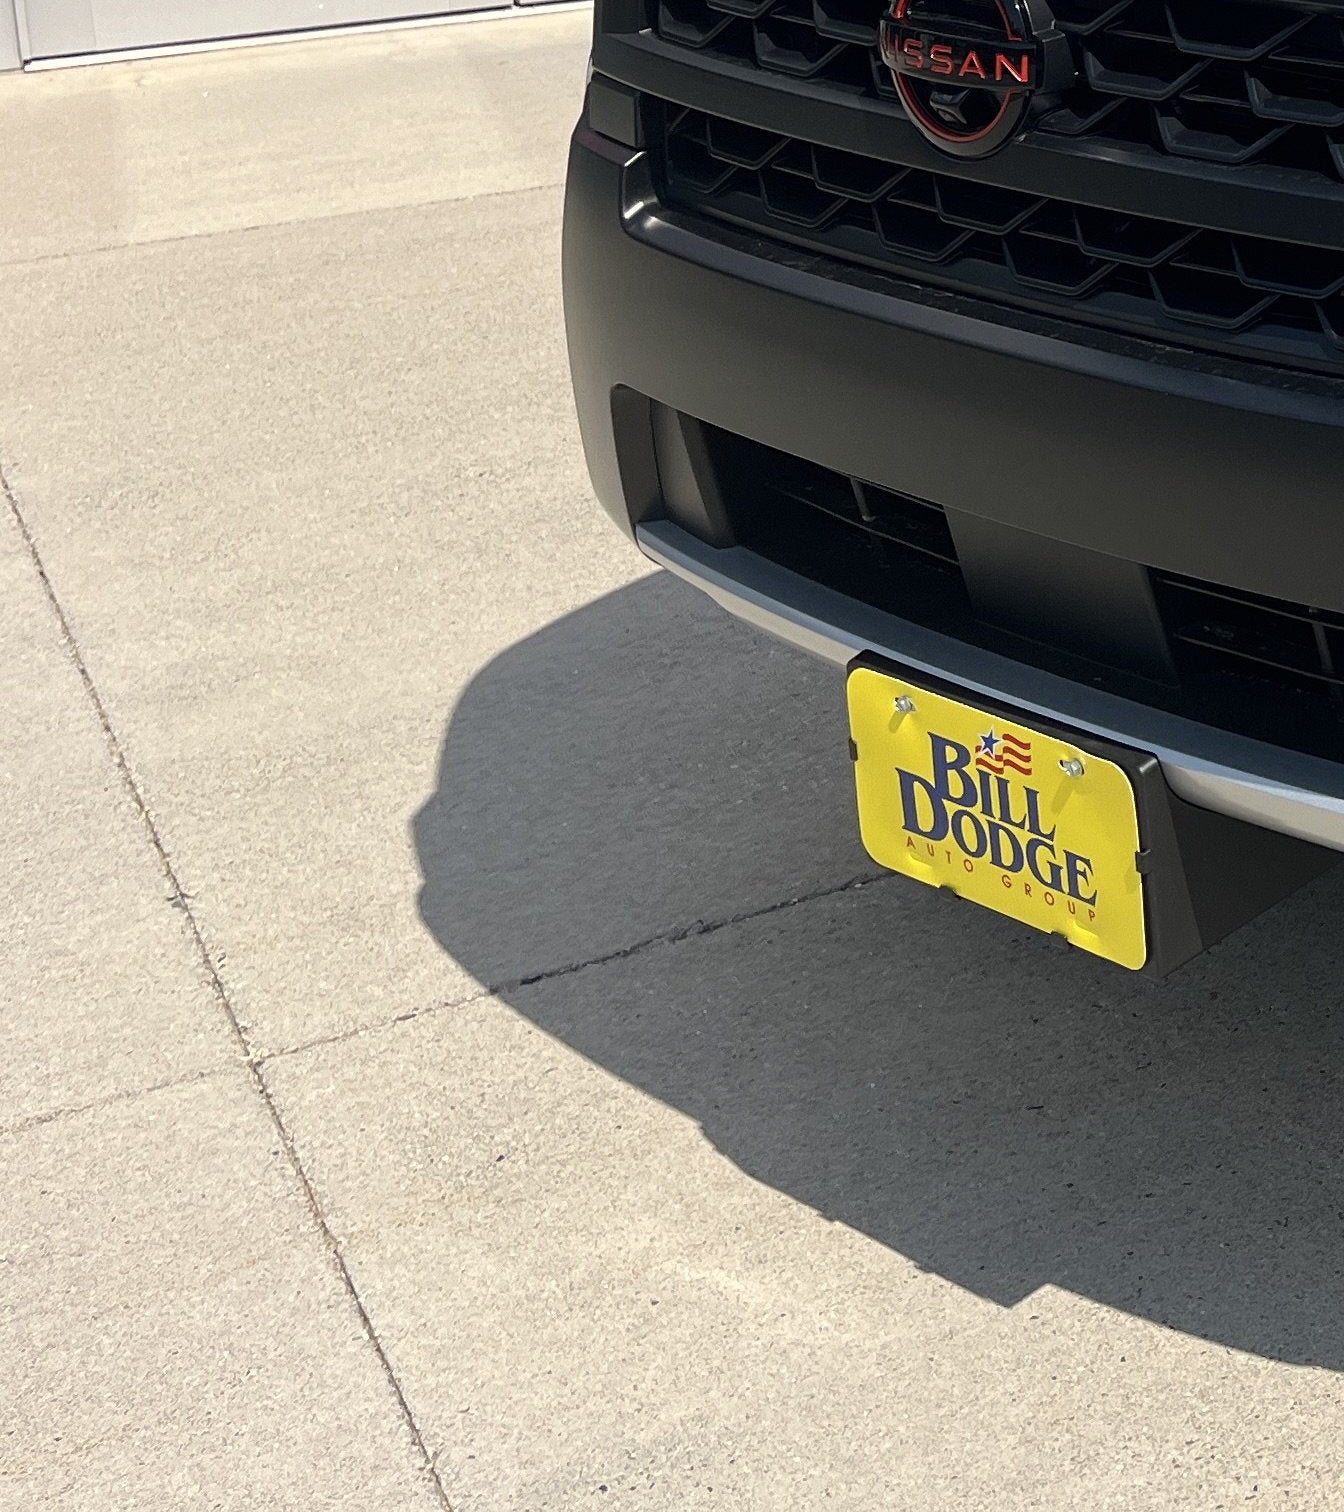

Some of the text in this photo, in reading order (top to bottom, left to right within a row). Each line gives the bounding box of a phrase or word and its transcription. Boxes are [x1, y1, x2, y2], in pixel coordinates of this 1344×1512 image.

[881, 28, 1030, 84] NISSAN
[927, 730, 1057, 843] BILL
[895, 767, 1098, 908] DODGE
[905, 835, 1098, 923] AUTO GROUP
